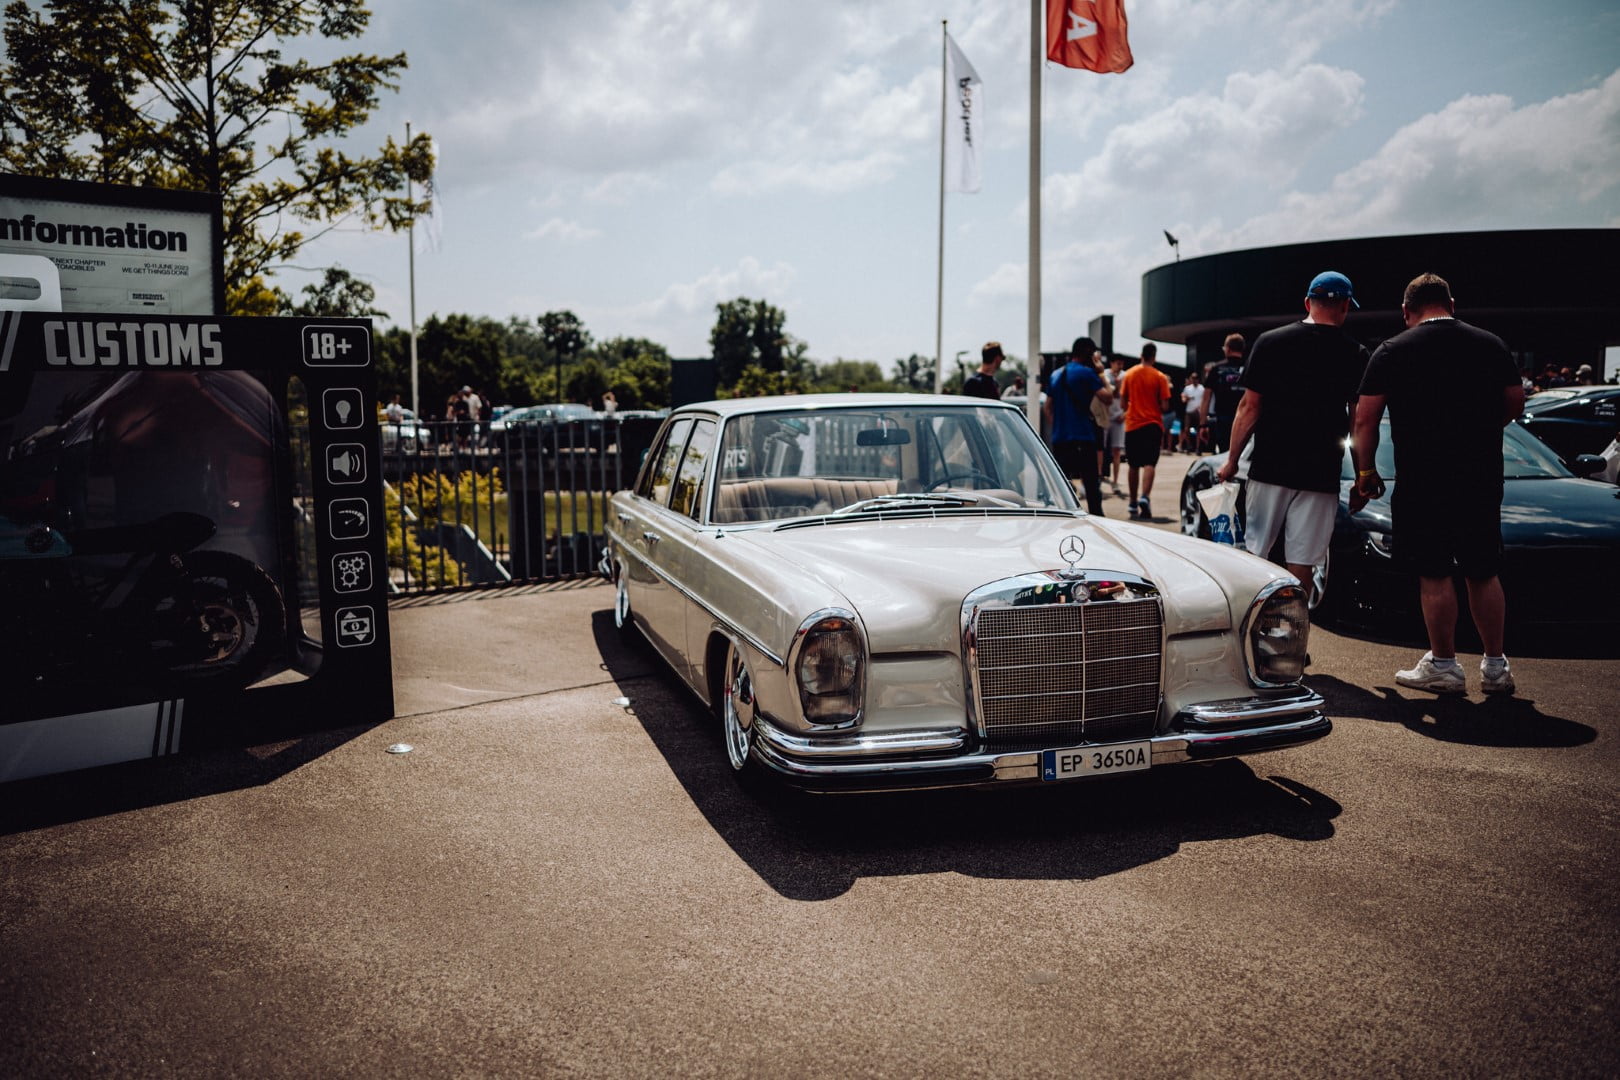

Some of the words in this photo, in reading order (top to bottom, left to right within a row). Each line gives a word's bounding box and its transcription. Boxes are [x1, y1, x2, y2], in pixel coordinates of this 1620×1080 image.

[1067, 0, 1098, 42] A
[0, 214, 188, 252] nformation
[55, 257, 73, 265] NEXT
[74, 259, 106, 267] CHAPTER
[57, 263, 96, 272] TOMOBILES
[43, 321, 224, 367] CUSTOMS
[310, 332, 352, 360] 18+
[1060, 754, 1083, 773] EP
[1092, 747, 1146, 770] 3650A
